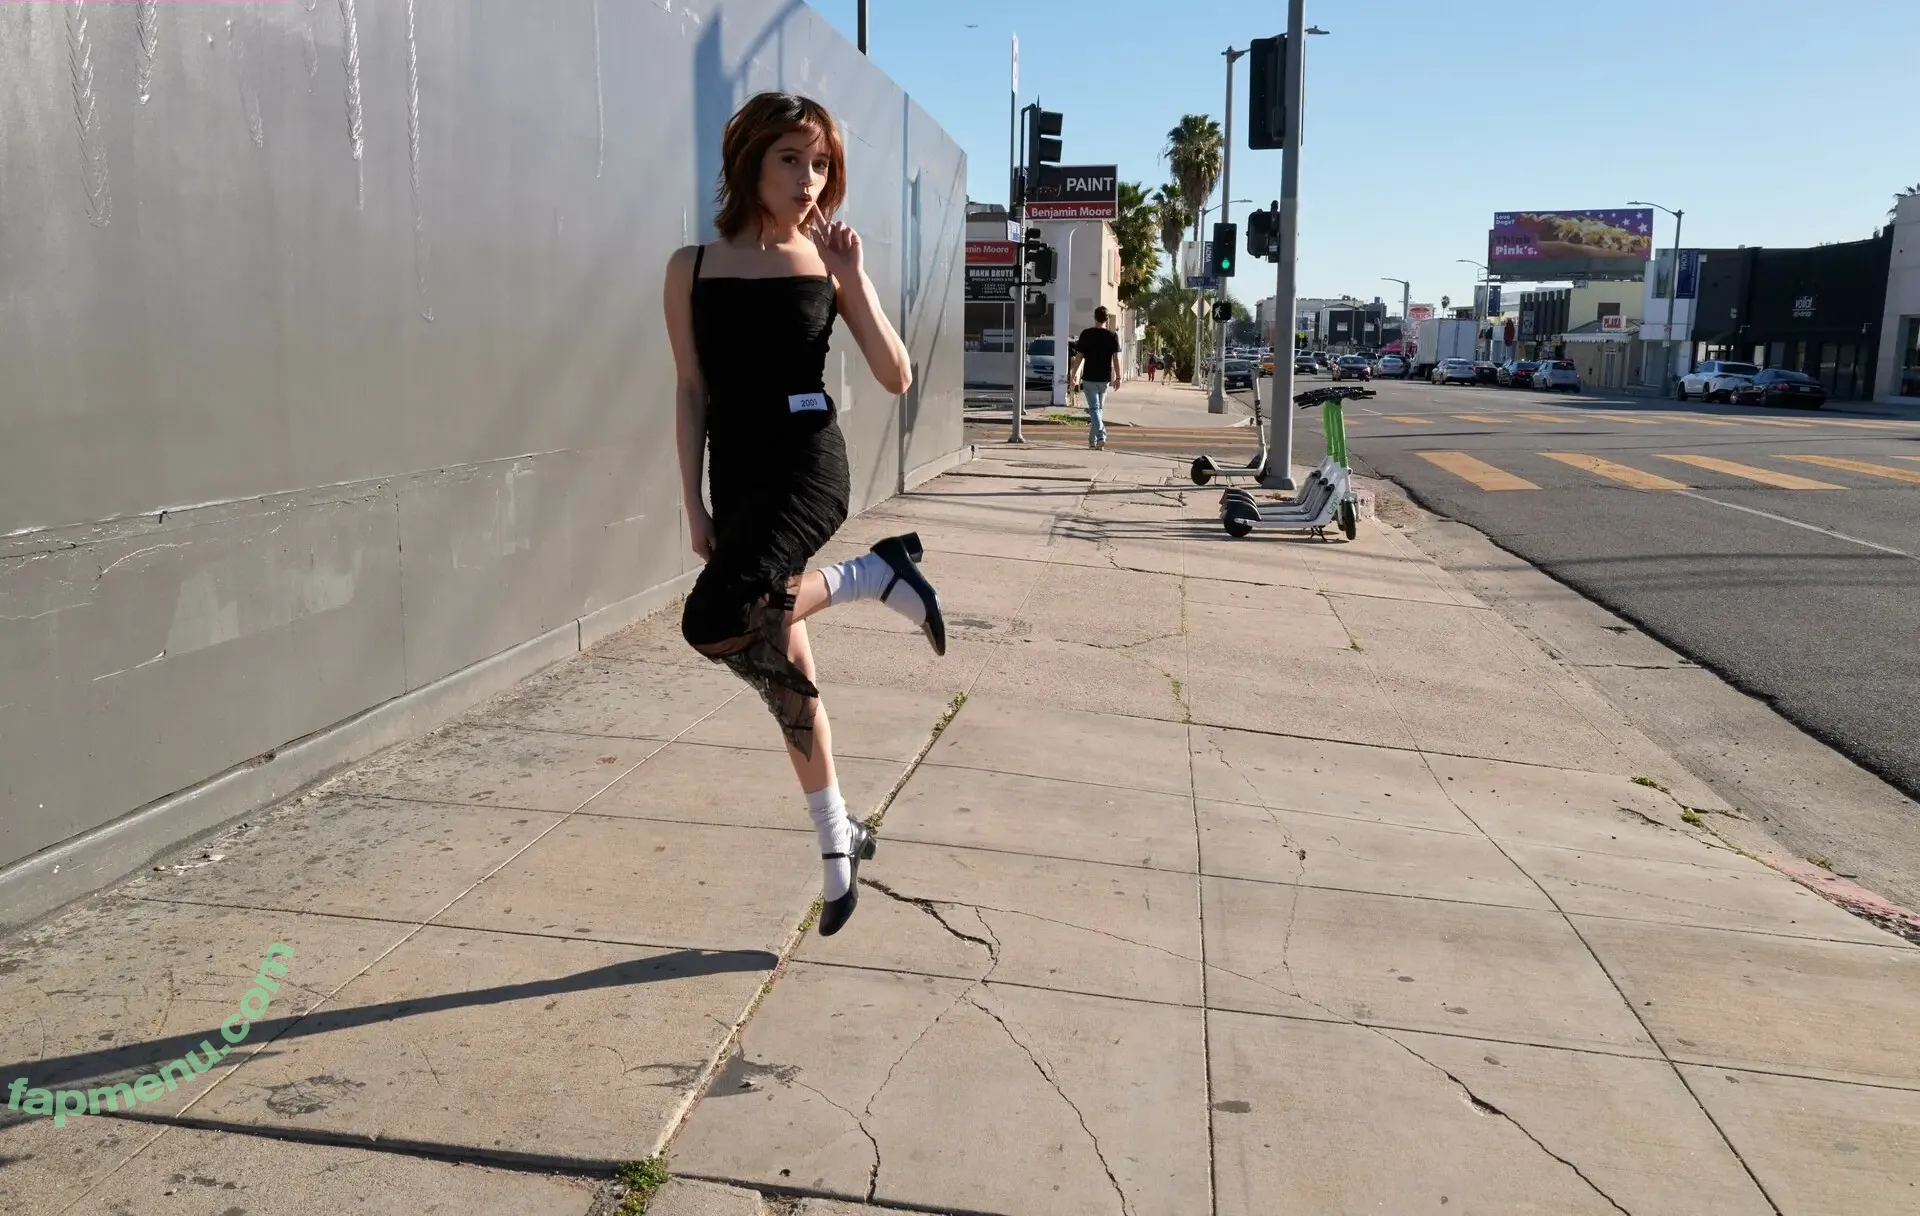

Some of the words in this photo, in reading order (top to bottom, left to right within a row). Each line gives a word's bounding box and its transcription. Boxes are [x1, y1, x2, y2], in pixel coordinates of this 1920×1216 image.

[1066, 177, 1114, 192] PAINT
[1031, 207, 1077, 219] Benjamin
[1080, 207, 1112, 216] Moore
[983, 245, 1009, 253] Moore
